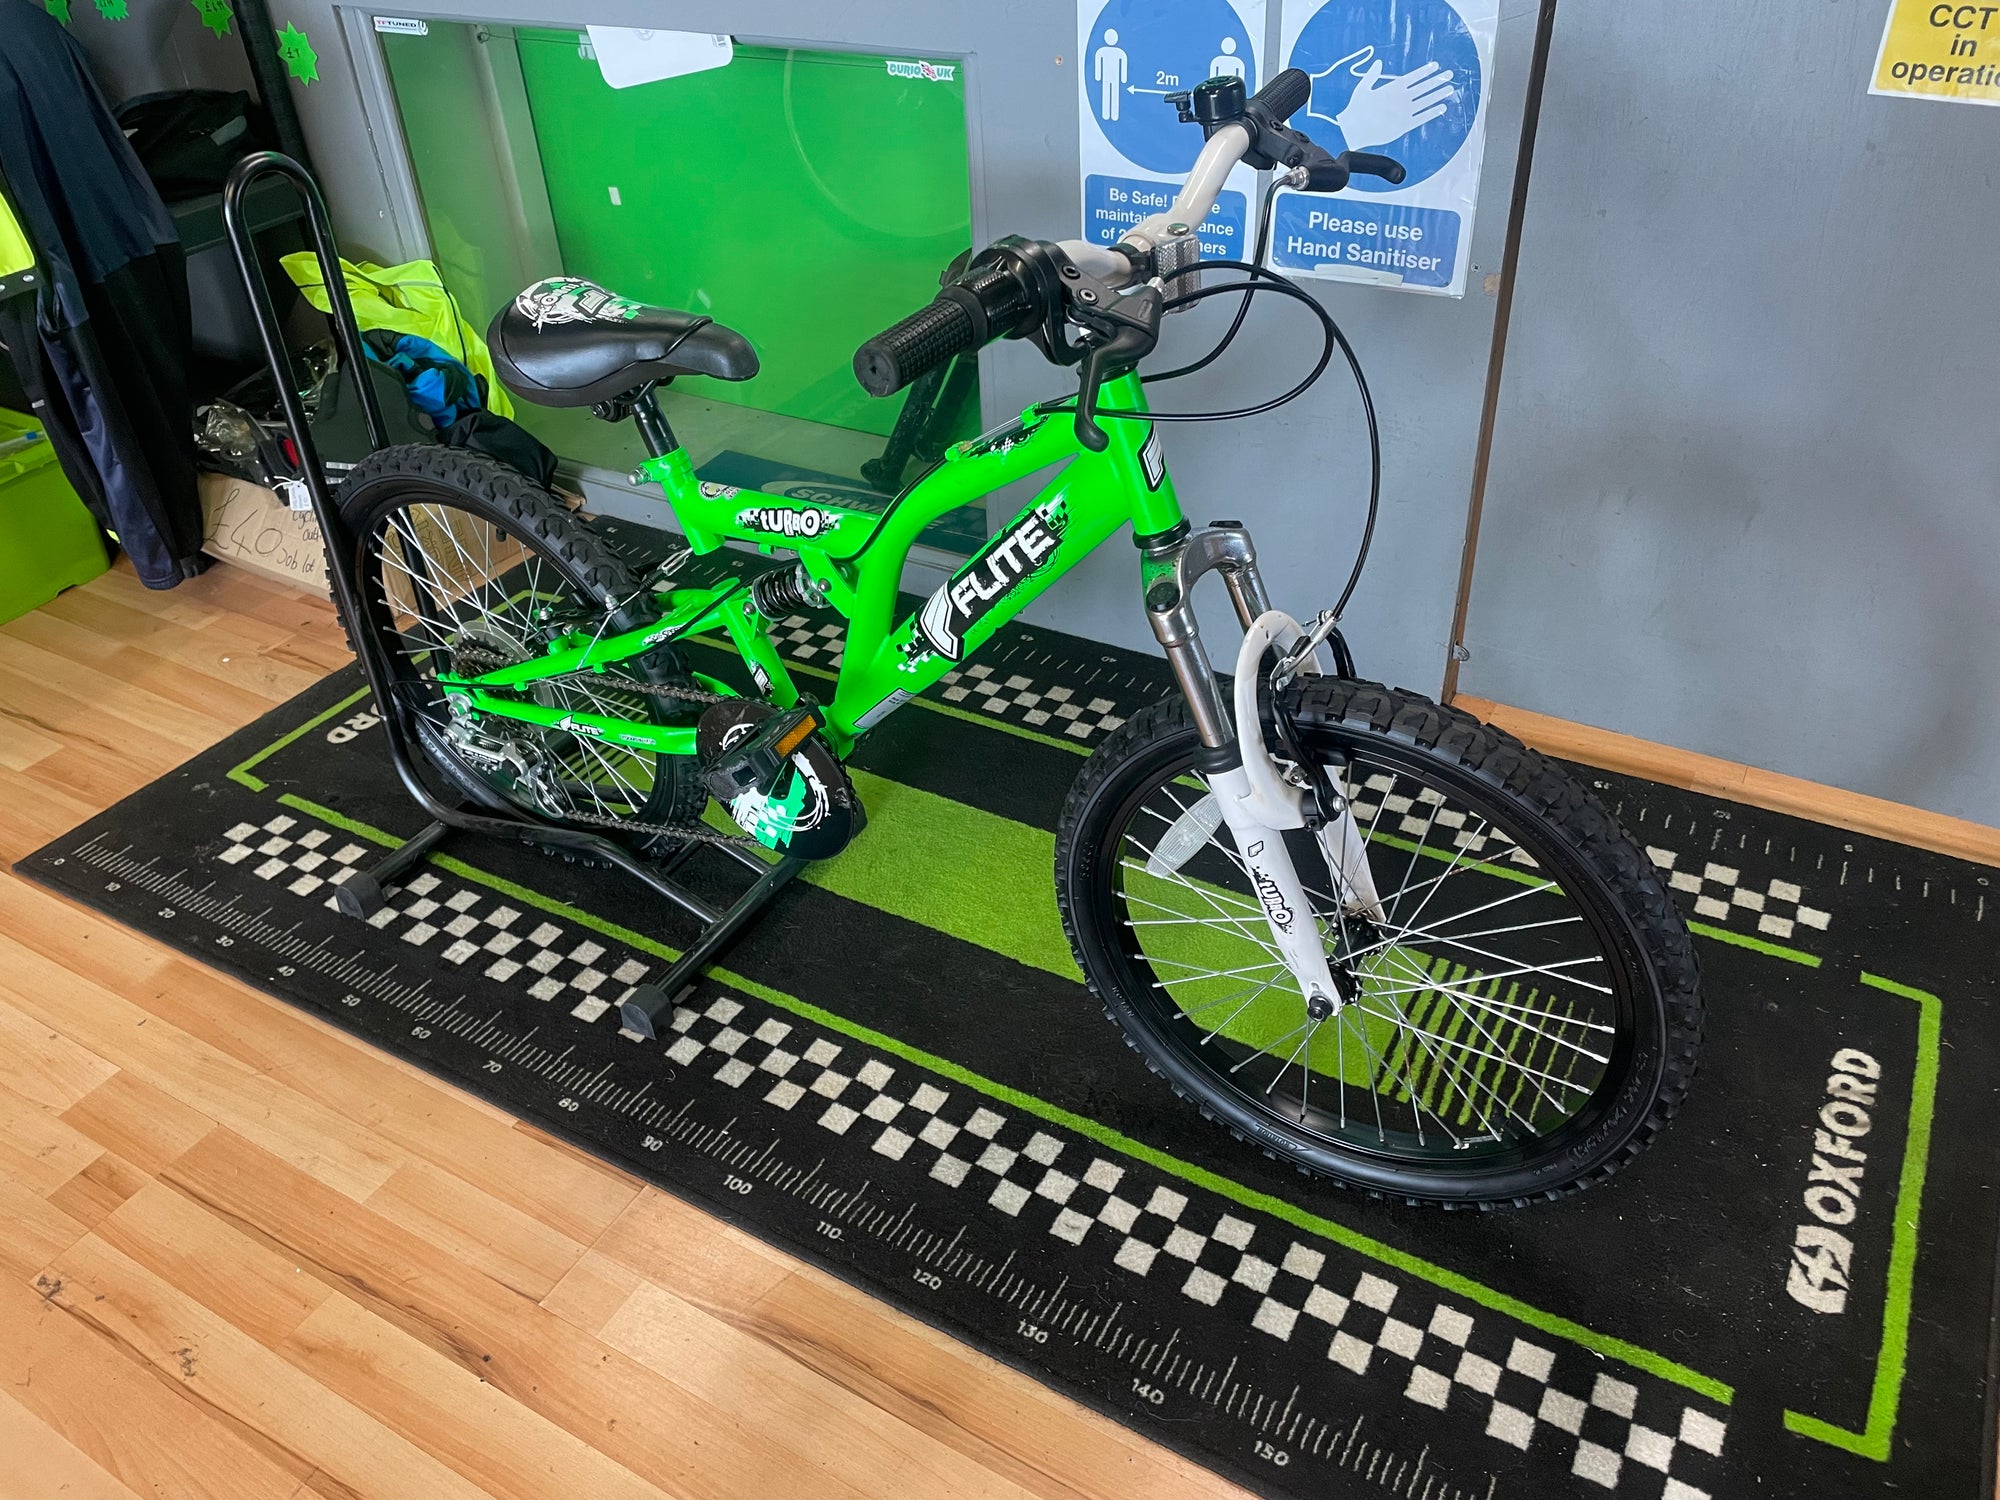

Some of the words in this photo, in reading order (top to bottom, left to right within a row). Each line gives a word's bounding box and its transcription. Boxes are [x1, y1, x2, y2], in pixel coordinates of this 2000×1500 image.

[1929, 4, 1999, 30] CCT
[1950, 33, 1978, 57] in
[936, 67, 952, 78] UK
[1156, 70, 1179, 87] 2m
[1109, 187, 1128, 203] Be
[1132, 190, 1168, 208] Safe!
[1095, 208, 1150, 224] maintai
[1101, 226, 1116, 240] of
[1198, 222, 1234, 237] ance
[1308, 211, 1378, 236] Please
[1384, 224, 1423, 241] use
[1287, 236, 1341, 259] Hand
[1346, 243, 1442, 271] Sanitiser
[951, 515, 1057, 619] FLITE
[104, 882, 121, 892] 10
[158, 907, 176, 919] 20
[216, 934, 234, 947] 30
[276, 964, 296, 978] 40
[342, 993, 360, 1007] 50
[412, 1025, 431, 1040] 60
[482, 1060, 502, 1074] 70
[558, 1096, 580, 1112] 80
[641, 1135, 663, 1152] 90
[1803, 1048, 1881, 1225] OXFORD
[723, 1174, 753, 1196] 100
[817, 1220, 842, 1241] 110
[913, 1268, 942, 1291] 120
[1017, 1319, 1048, 1345] 130
[1131, 1378, 1165, 1406] 140
[1254, 1440, 1290, 1468] 150
